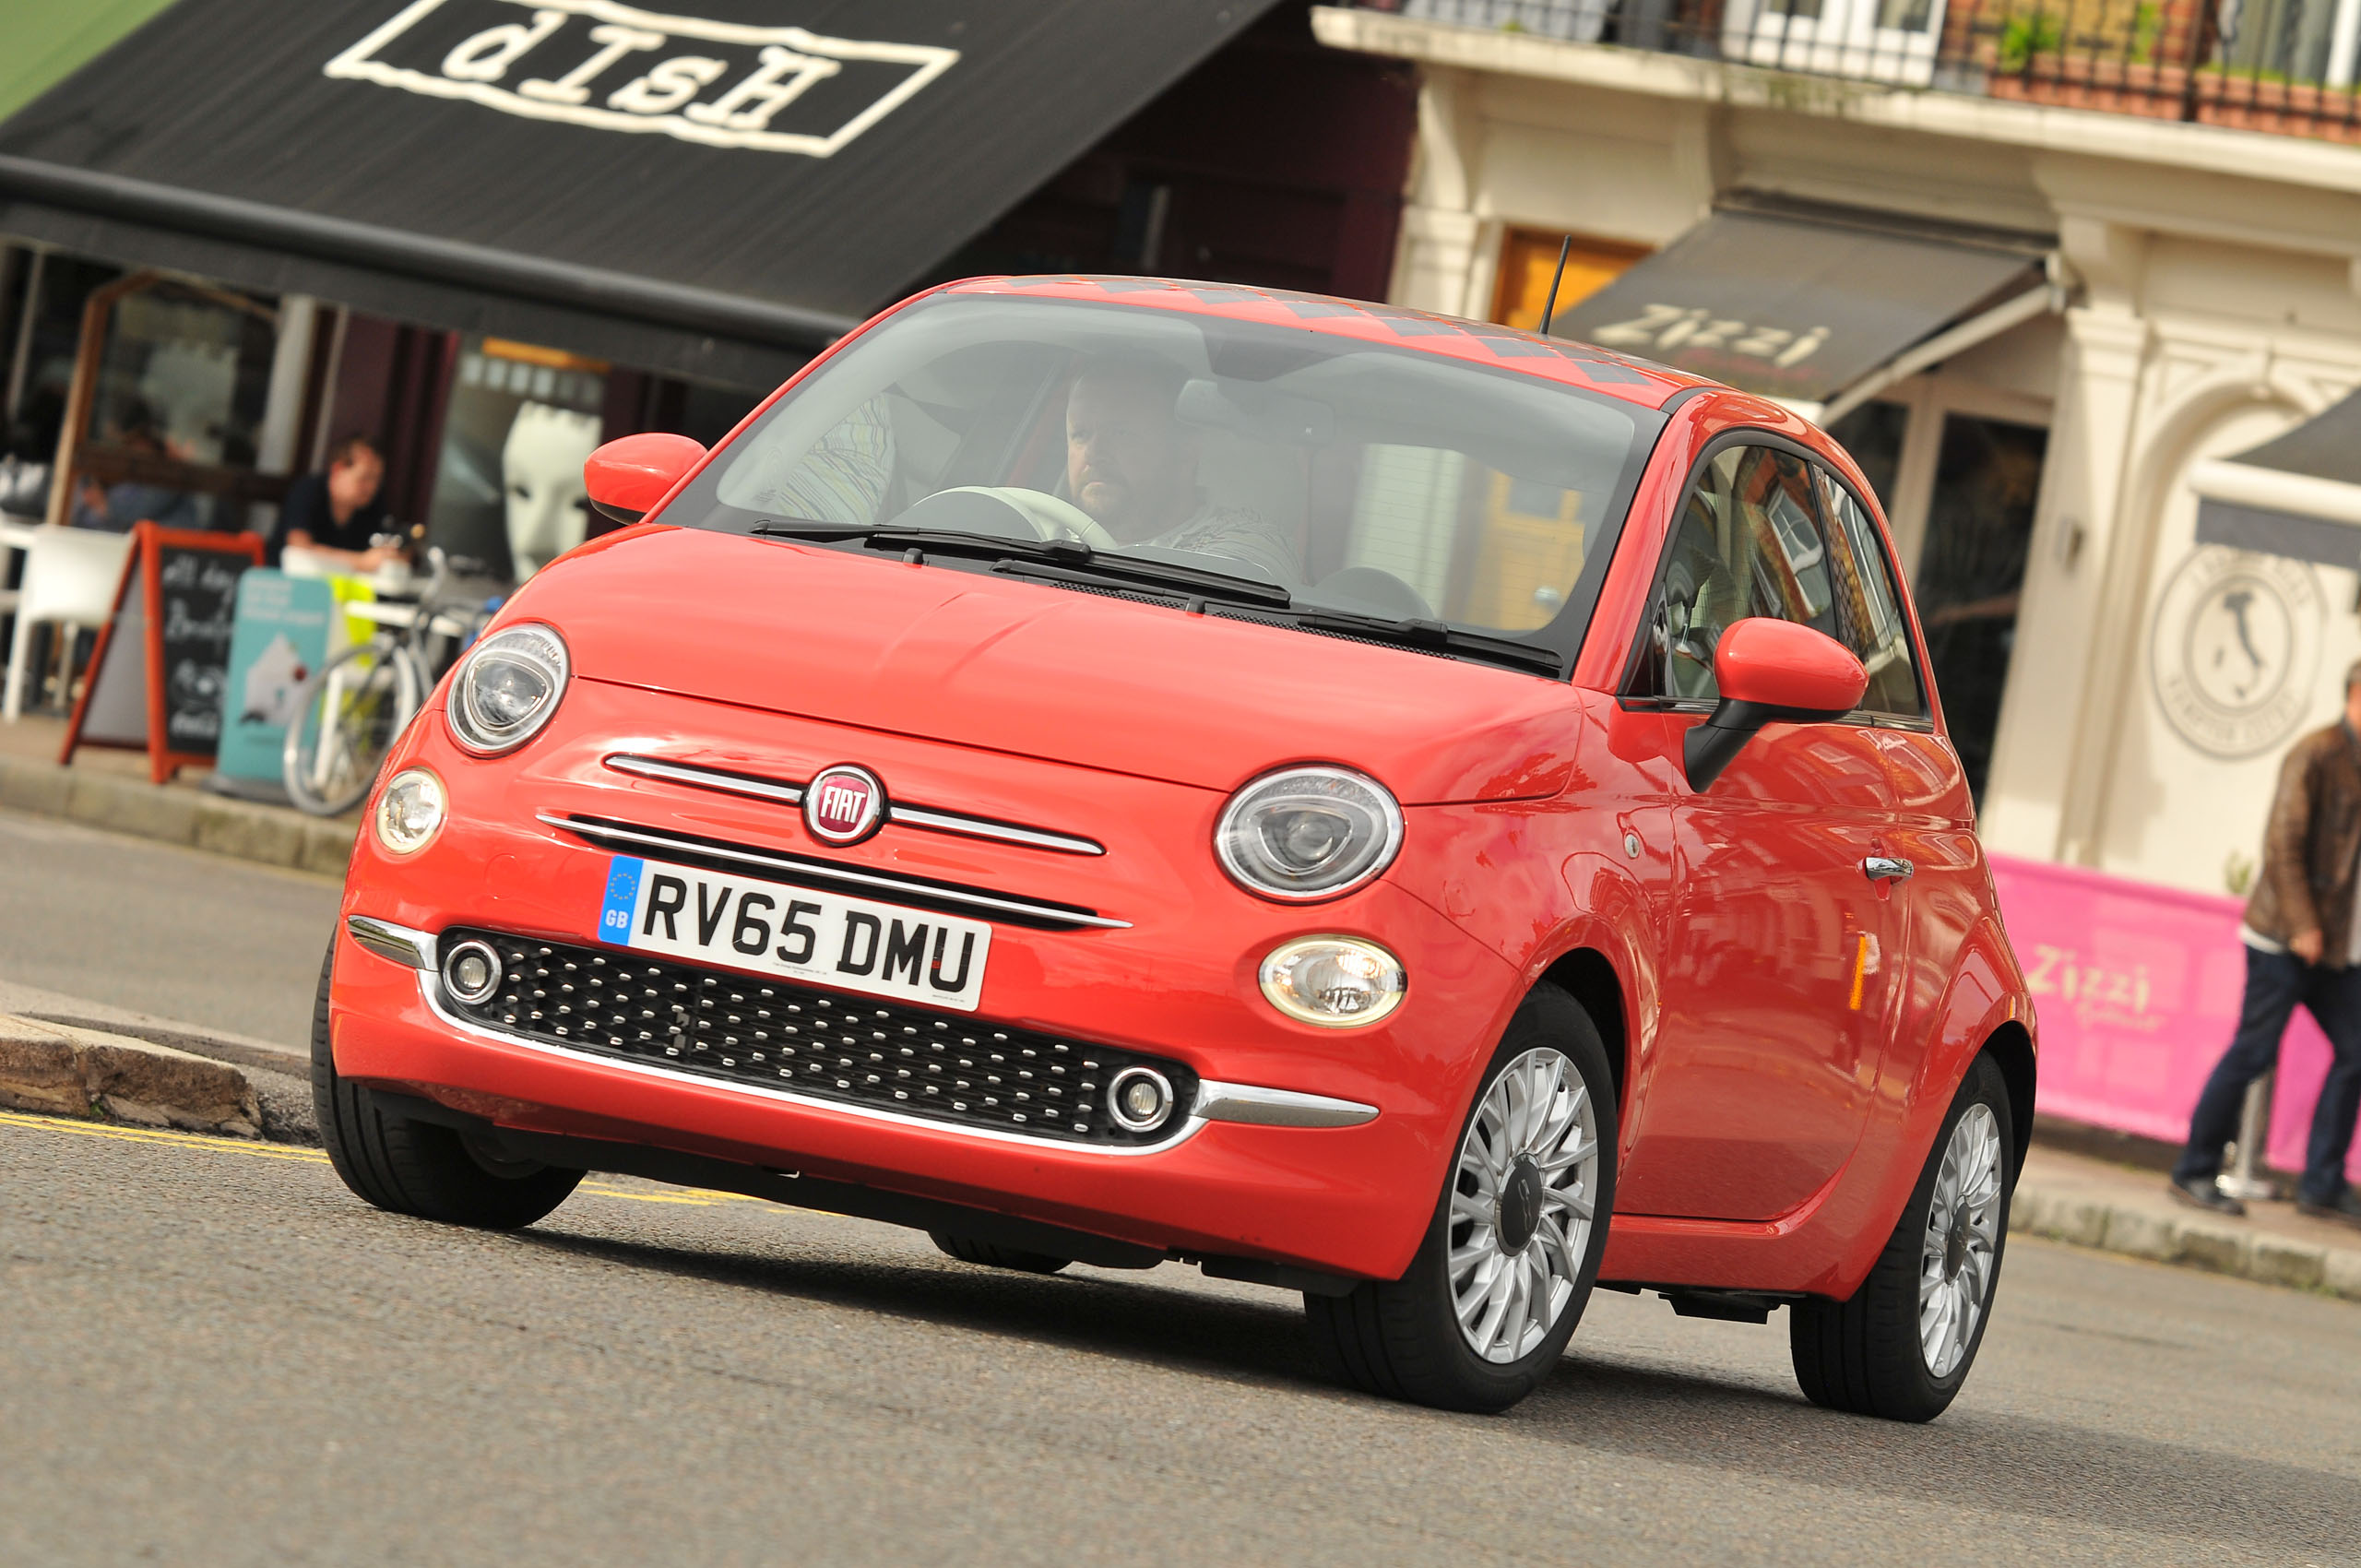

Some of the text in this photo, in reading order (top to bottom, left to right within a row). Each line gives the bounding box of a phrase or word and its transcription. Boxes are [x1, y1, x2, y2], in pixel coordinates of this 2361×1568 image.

[820, 785, 867, 824] FIAT
[604, 909, 628, 929] GB
[643, 873, 976, 993] RV65 DMU
[2026, 944, 2151, 1015] Zizzi
